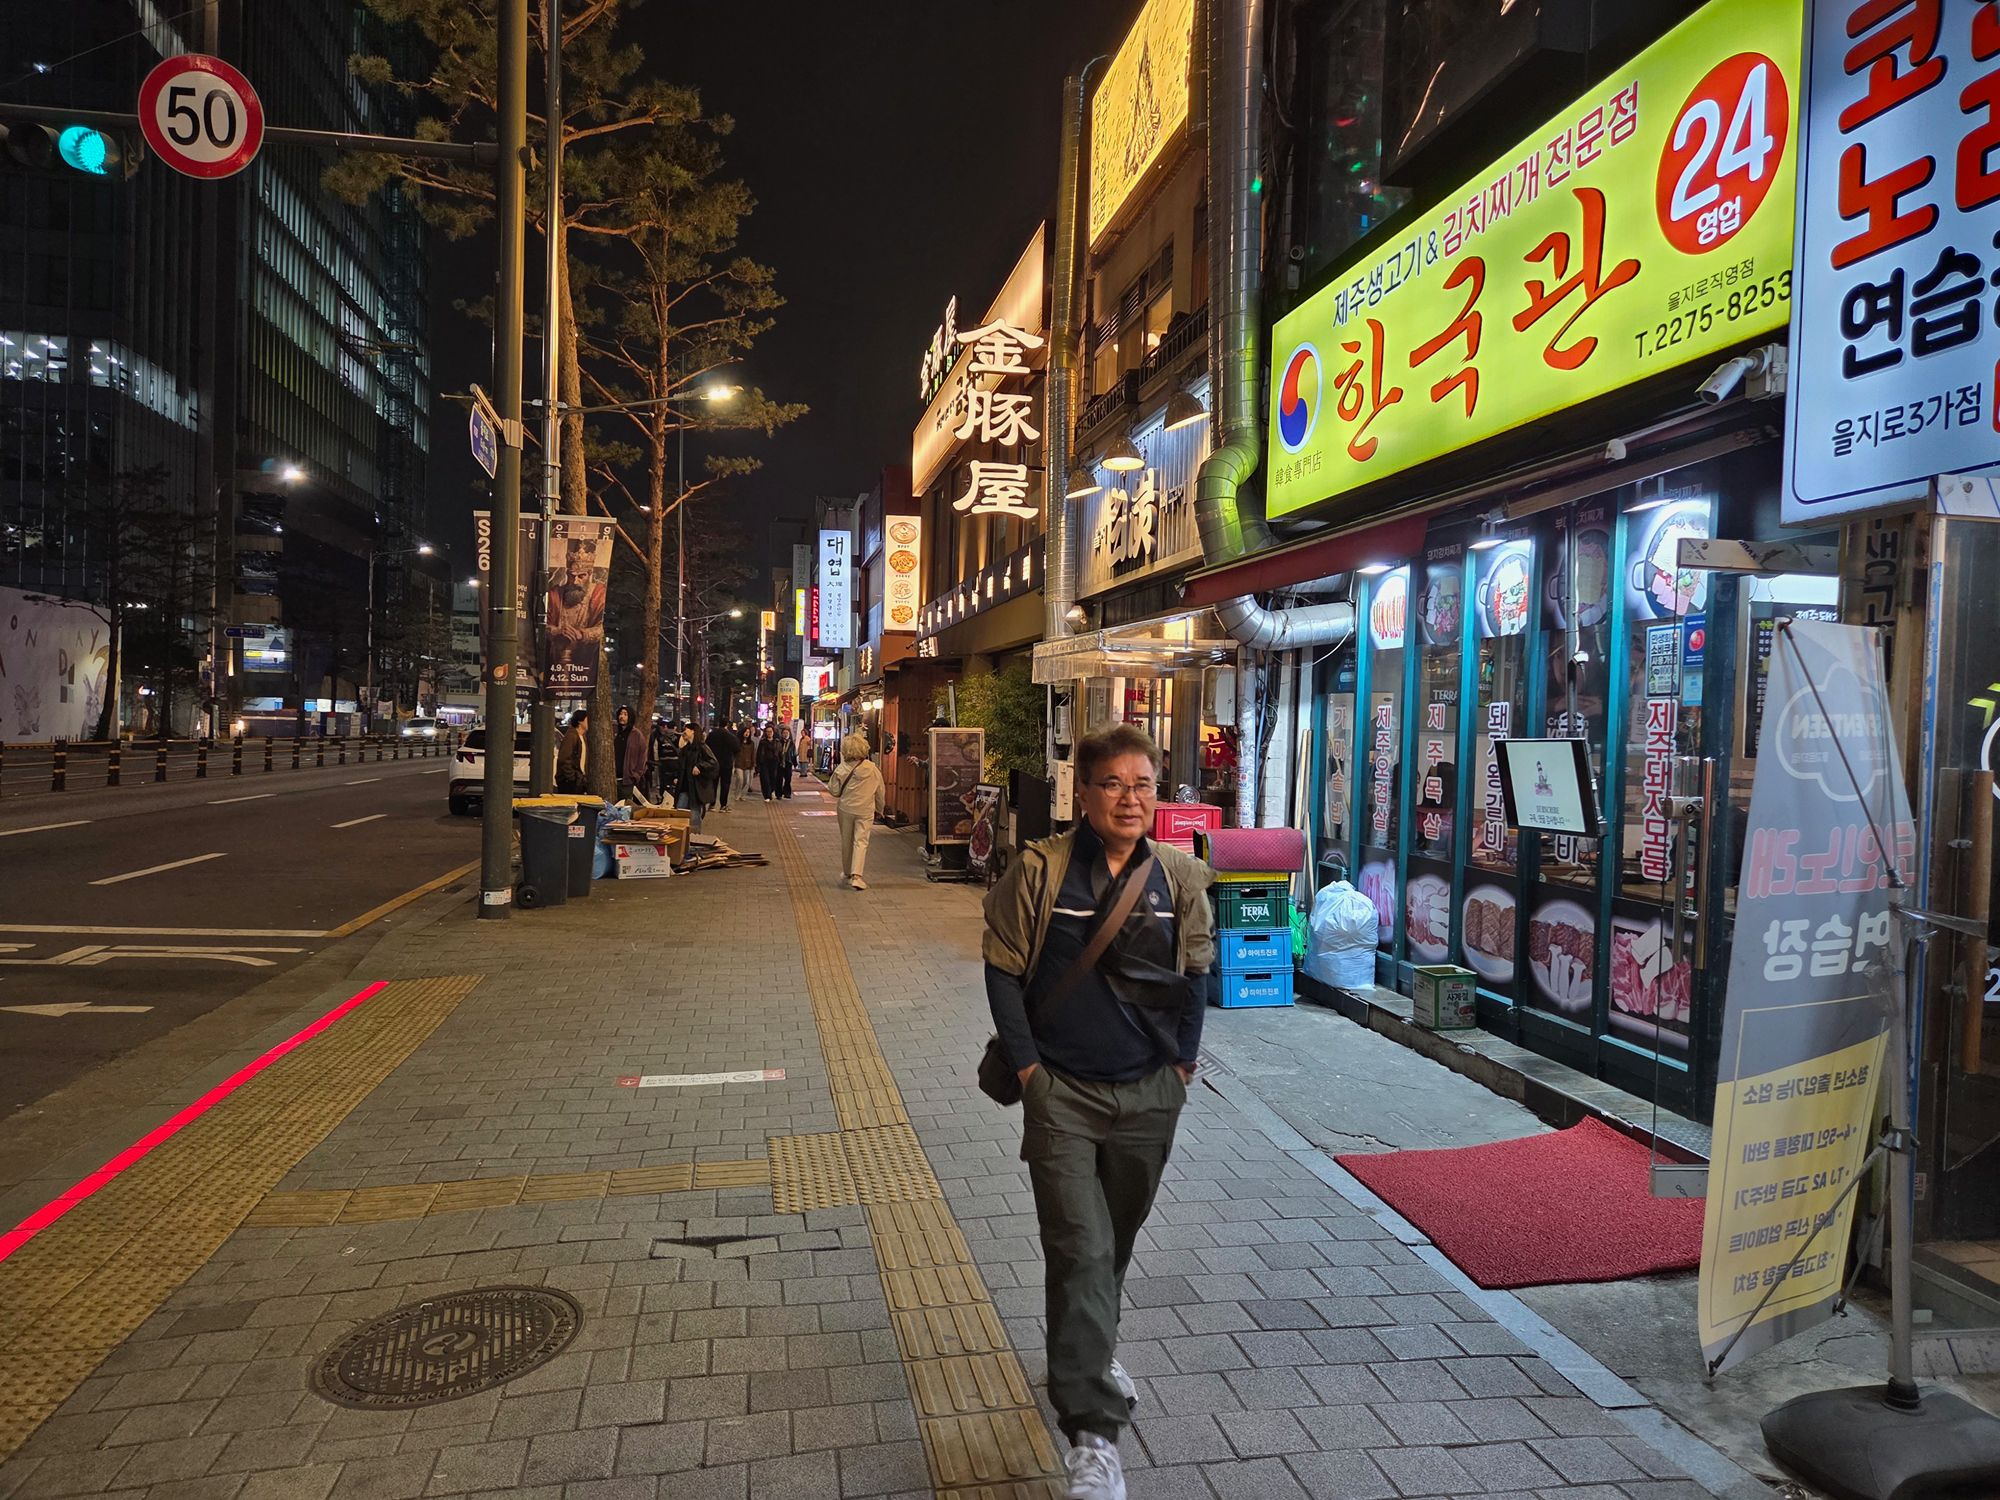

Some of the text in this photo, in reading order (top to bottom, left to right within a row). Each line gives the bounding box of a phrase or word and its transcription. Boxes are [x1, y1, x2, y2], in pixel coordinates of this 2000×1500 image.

[167, 86, 237, 149] 50
[1670, 62, 1773, 221] 24
[1333, 80, 1638, 327] 제주생고기 & 김치찌개 전문점
[1696, 196, 1741, 245] 영업
[1635, 269, 1792, 359] T.2275-8253
[1668, 257, 1754, 311] 을지로직영점
[1841, 240, 2000, 379] 연습
[1333, 187, 1641, 462] 한국관
[953, 318, 1044, 519] 金豚屋
[1832, 382, 1981, 457] 을지로3가점
[827, 537, 843, 576] 대엽
[570, 673, 588, 681] Sun
[1373, 705, 1392, 832] 제주오겹살
[1423, 703, 1445, 840] 제주목살
[1241, 904, 1270, 917] TERRA
[1248, 949, 1278, 957] 하이트진로
[1249, 988, 1279, 996] 하이트진로
